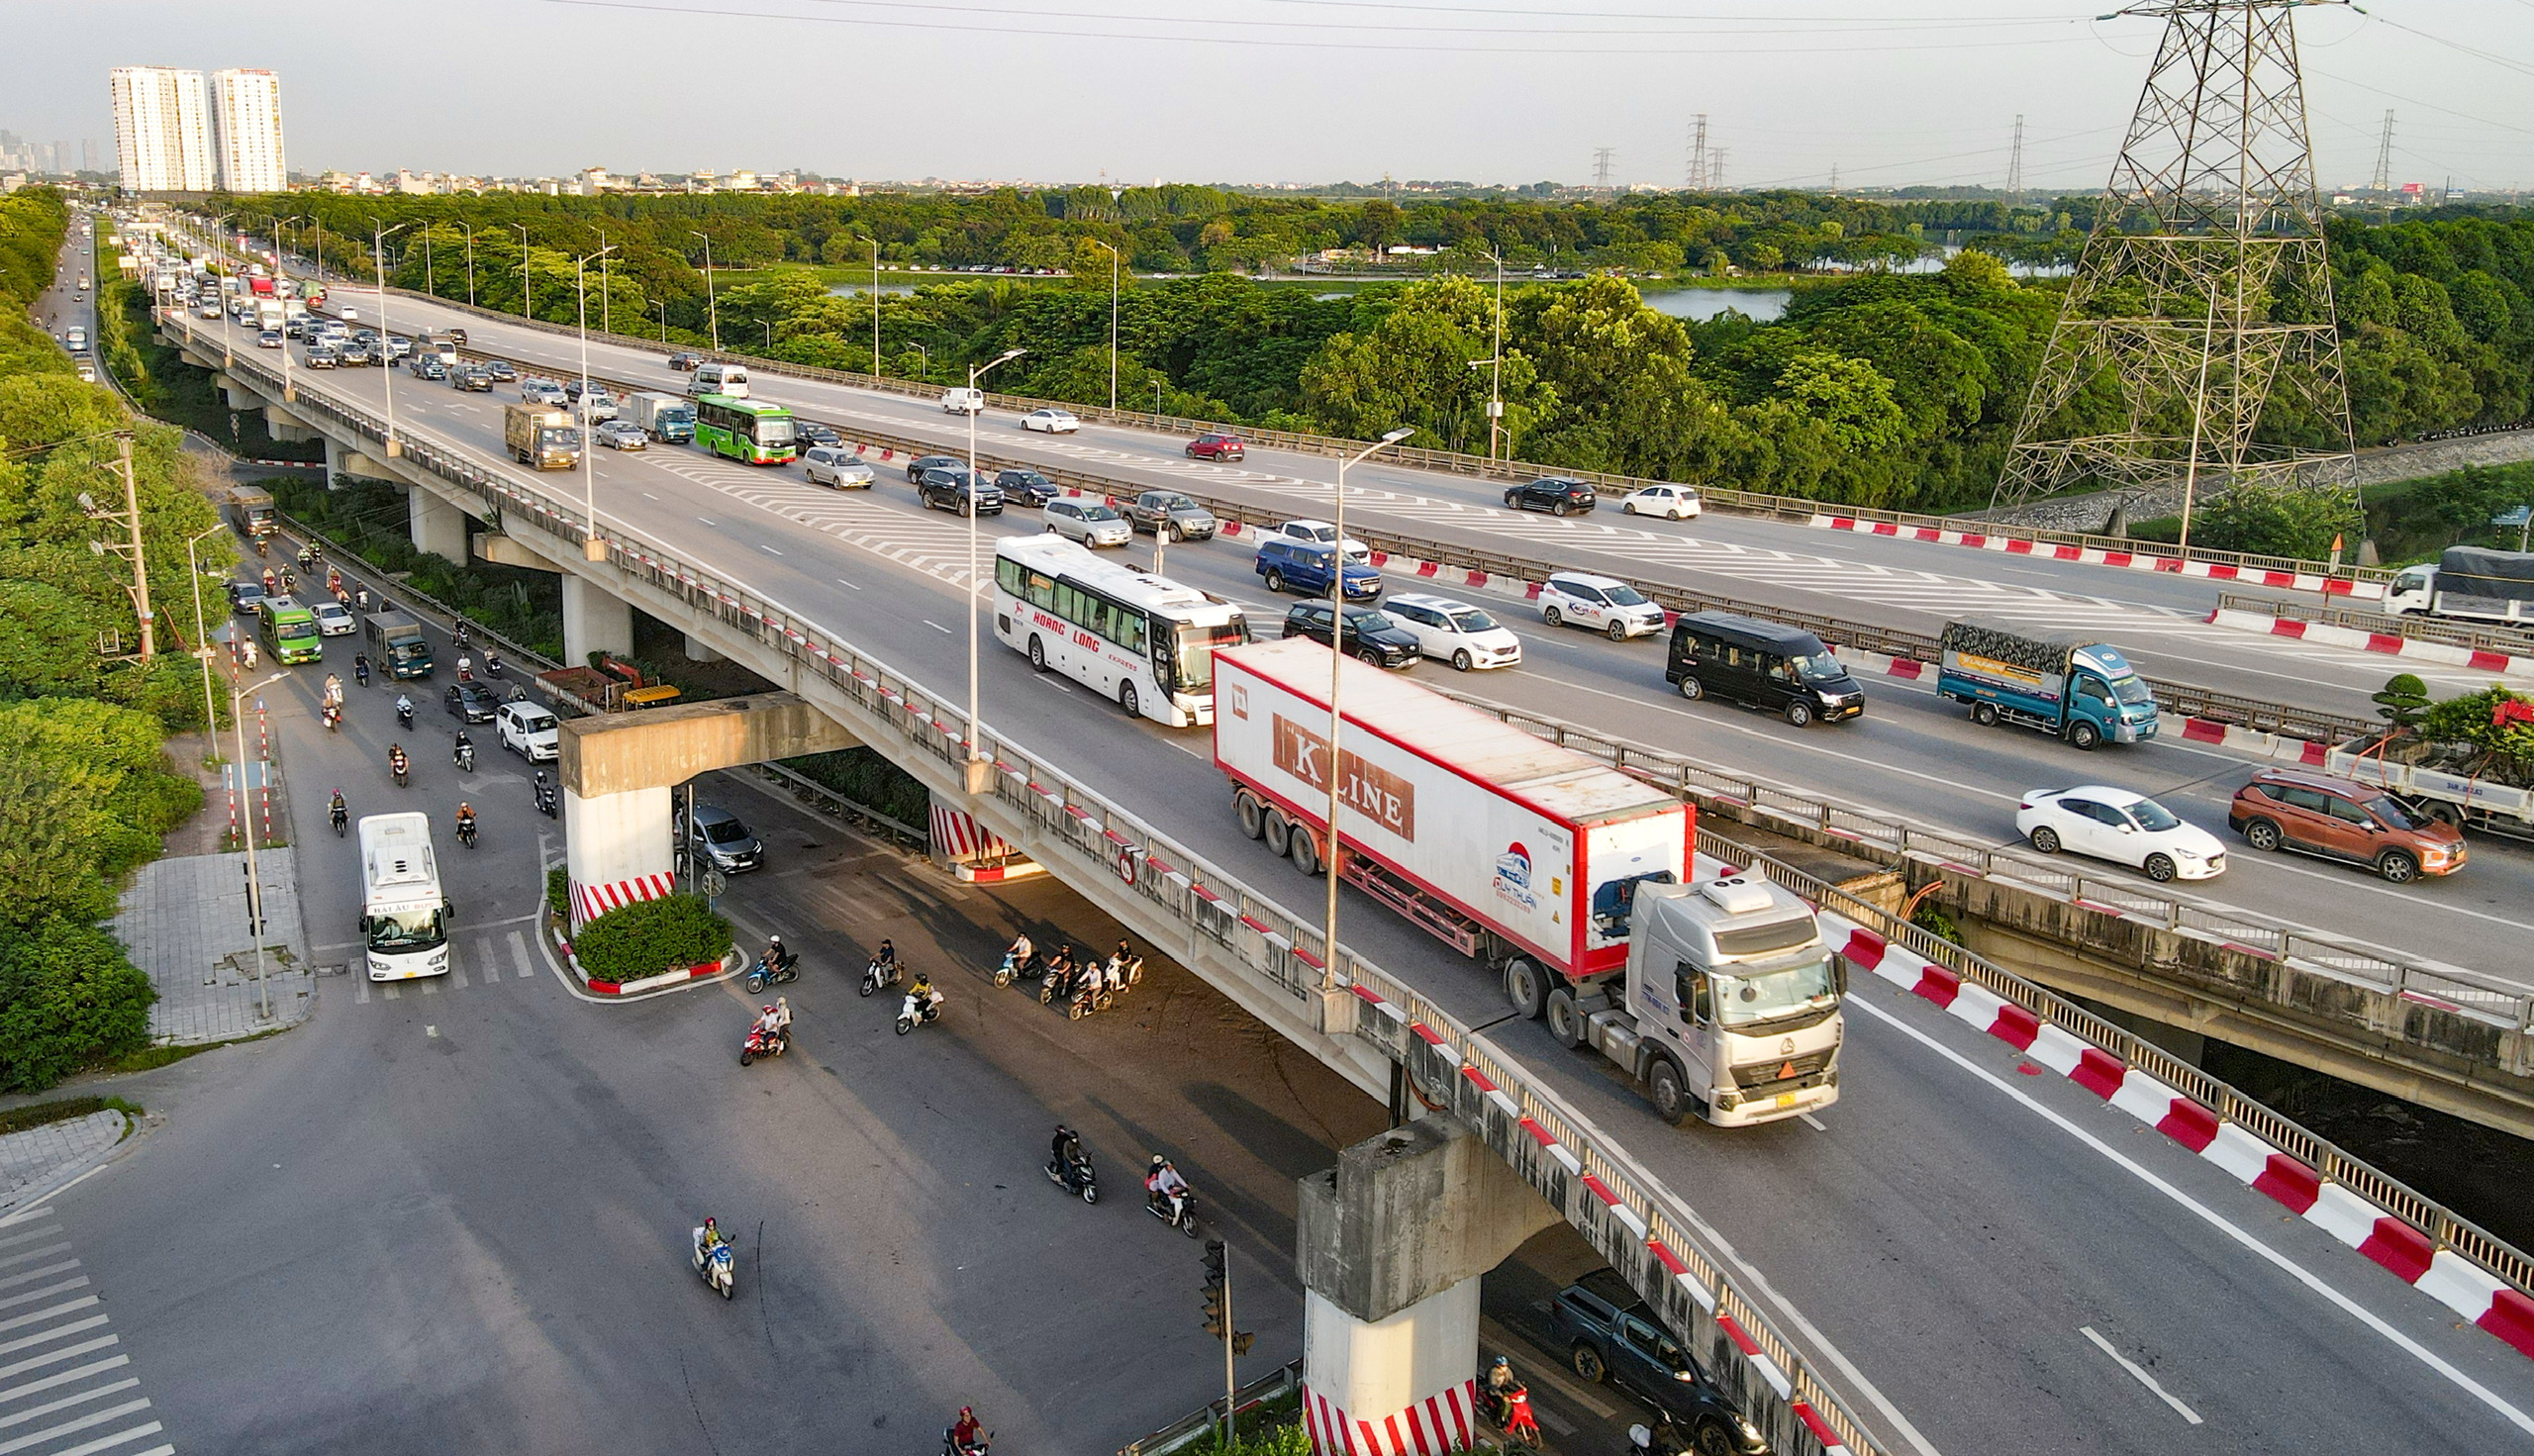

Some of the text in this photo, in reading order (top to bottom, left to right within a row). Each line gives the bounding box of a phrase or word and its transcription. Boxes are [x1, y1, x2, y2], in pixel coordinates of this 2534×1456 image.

[1033, 612, 1101, 653] HOANG LONG
[1108, 654, 1137, 672] EXPRESS
